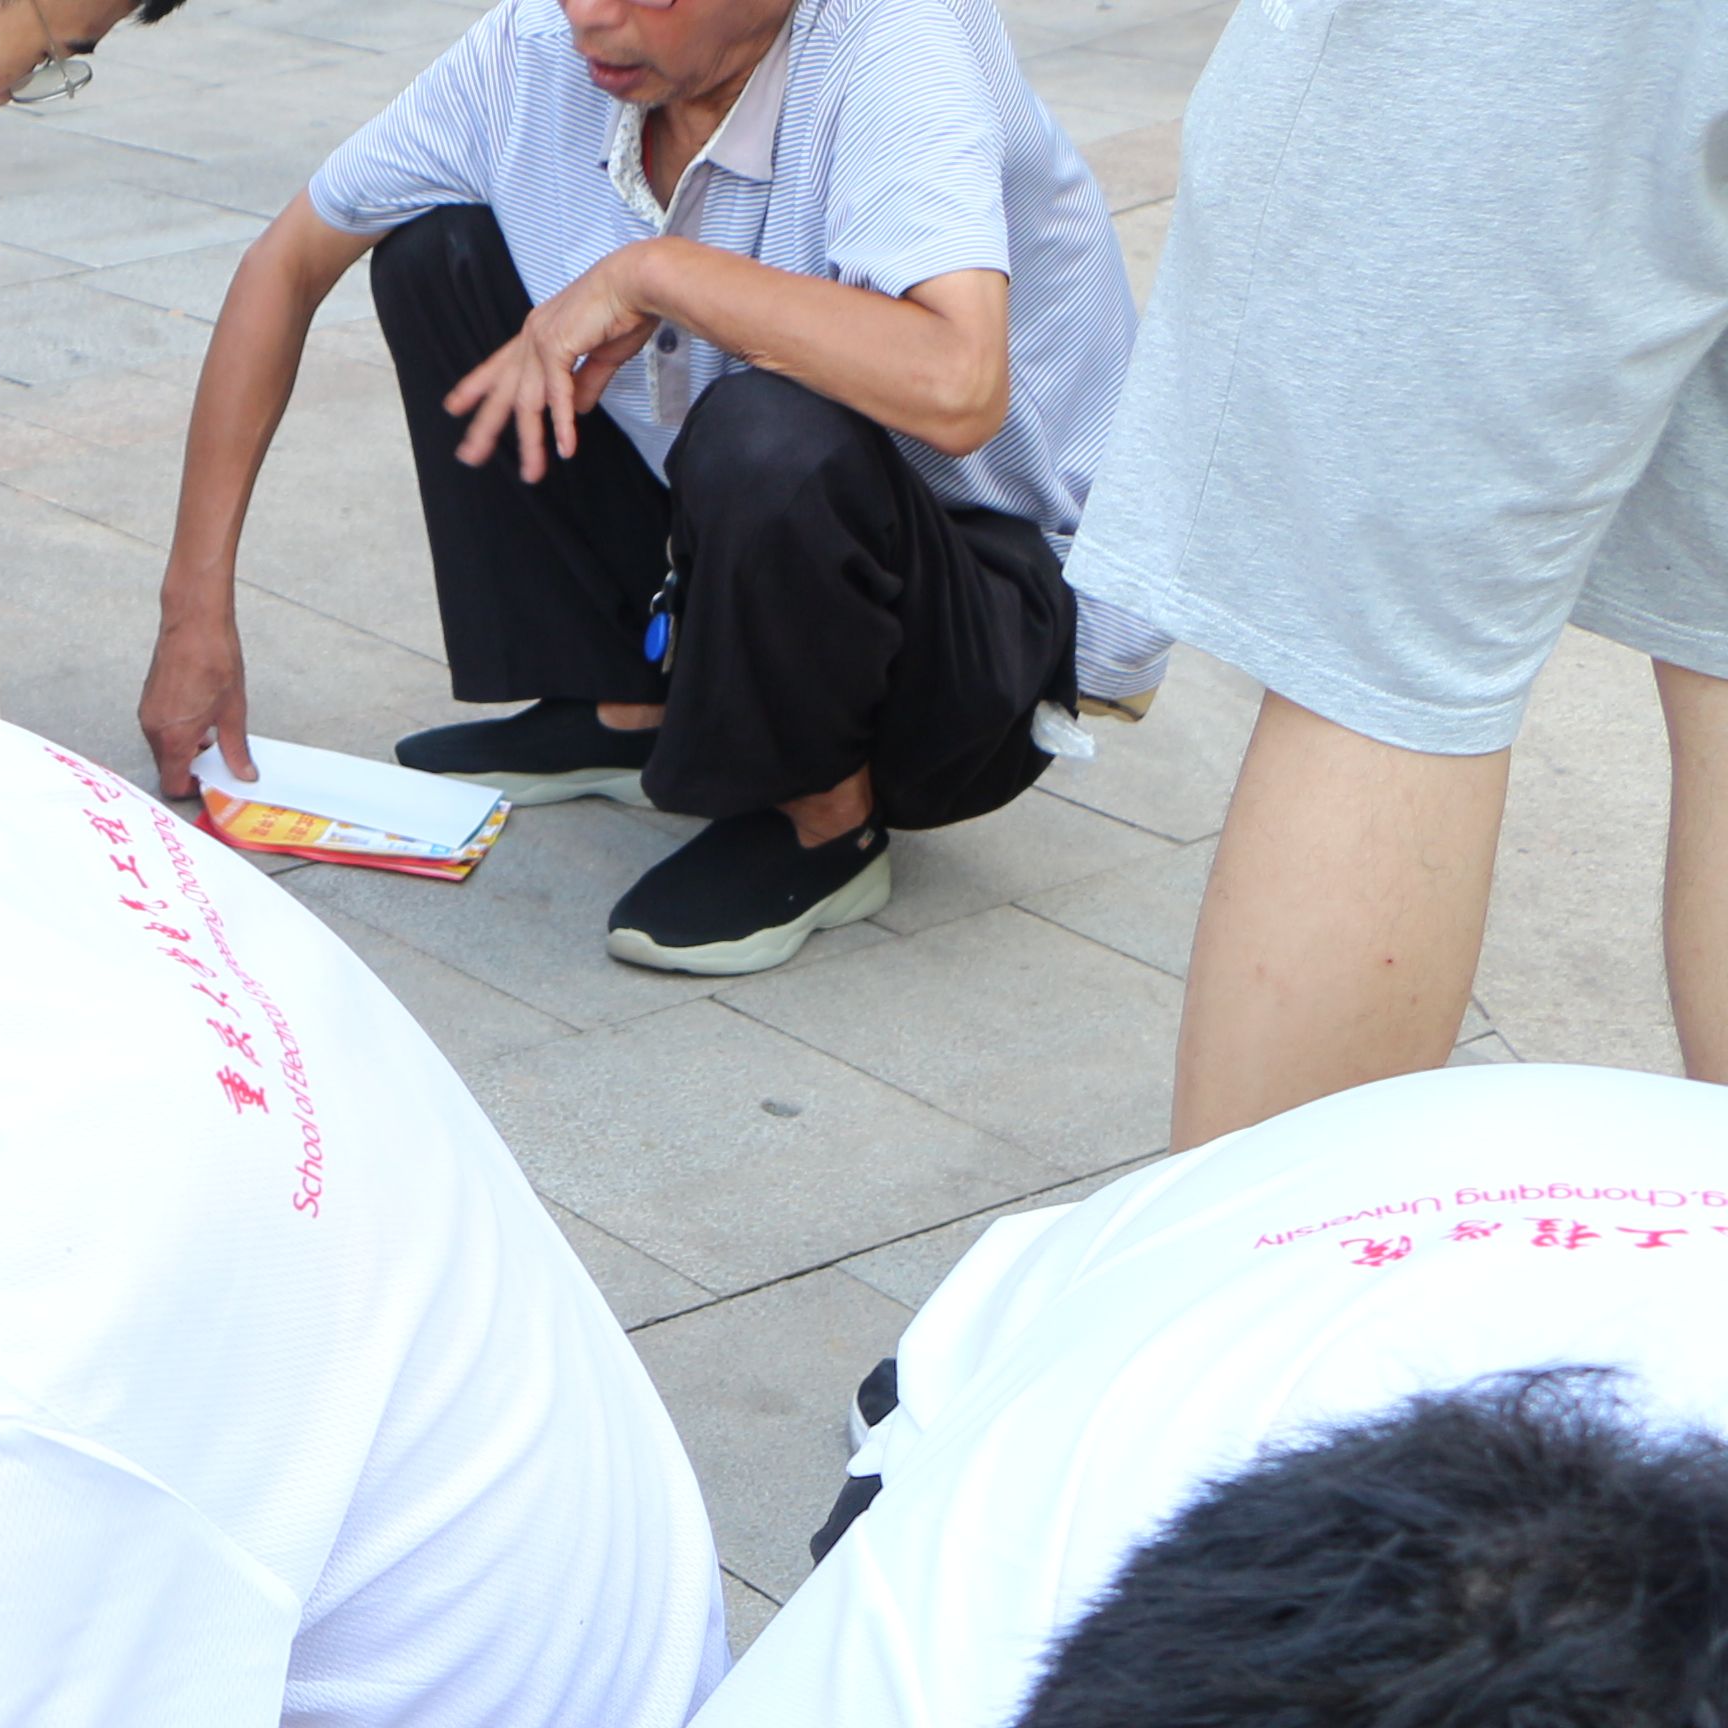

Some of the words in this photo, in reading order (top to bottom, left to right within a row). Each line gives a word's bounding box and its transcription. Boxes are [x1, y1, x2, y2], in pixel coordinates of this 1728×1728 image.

[284, 1081, 314, 1115] of
[292, 1111, 324, 1218] School
[1253, 1196, 1442, 1249] University
[1340, 1216, 1728, 1267] 工程学院
